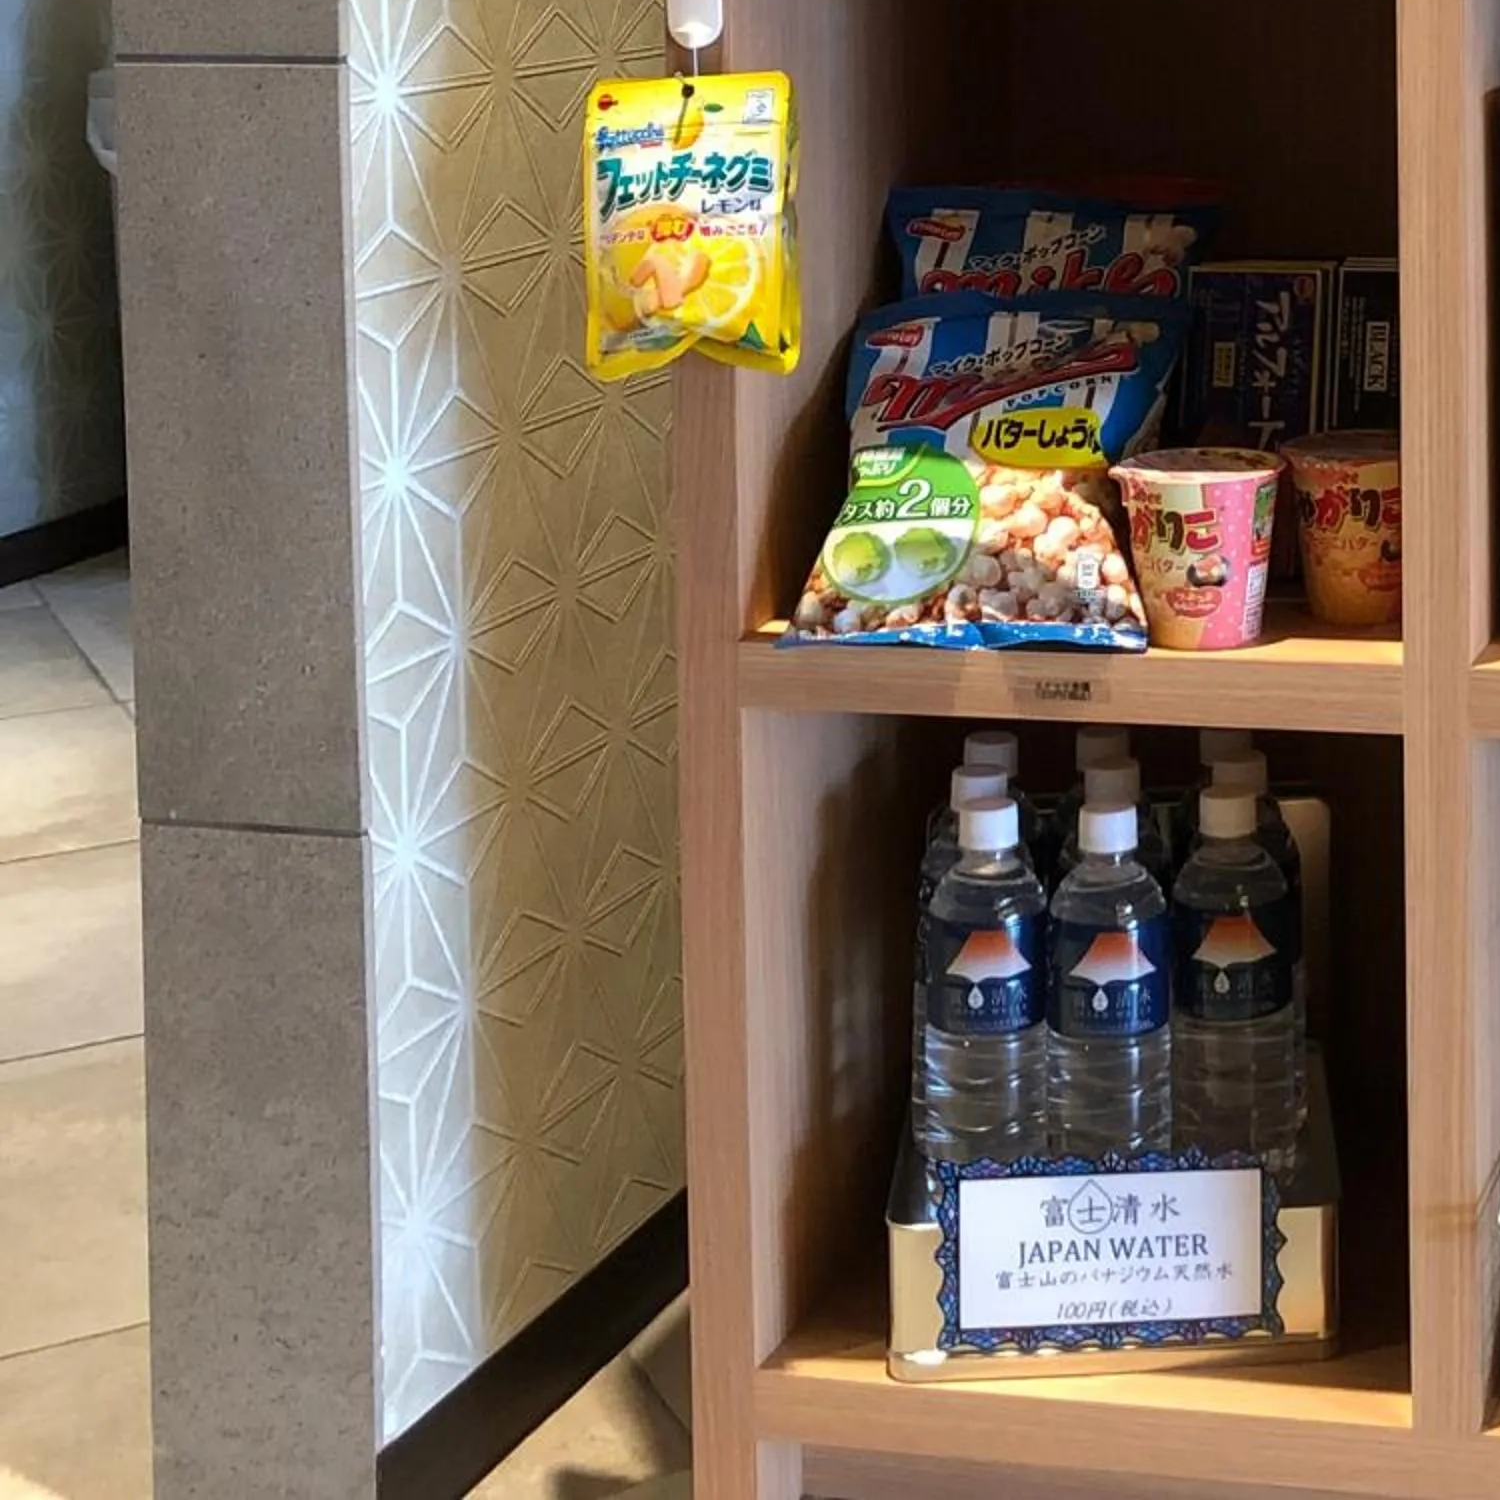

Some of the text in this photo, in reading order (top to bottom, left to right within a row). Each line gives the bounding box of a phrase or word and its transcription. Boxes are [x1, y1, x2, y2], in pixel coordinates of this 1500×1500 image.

[597, 151, 774, 223] フェットチーネグミ
[1007, 375, 1115, 406] POPCORN
[1040, 1192, 1180, 1228] 富士清水
[1018, 1233, 1209, 1268] JAPAN WATER
[994, 1263, 1234, 1291] 富士山のバナジウム天然水
[1056, 1296, 1173, 1321] 100円(税込)
